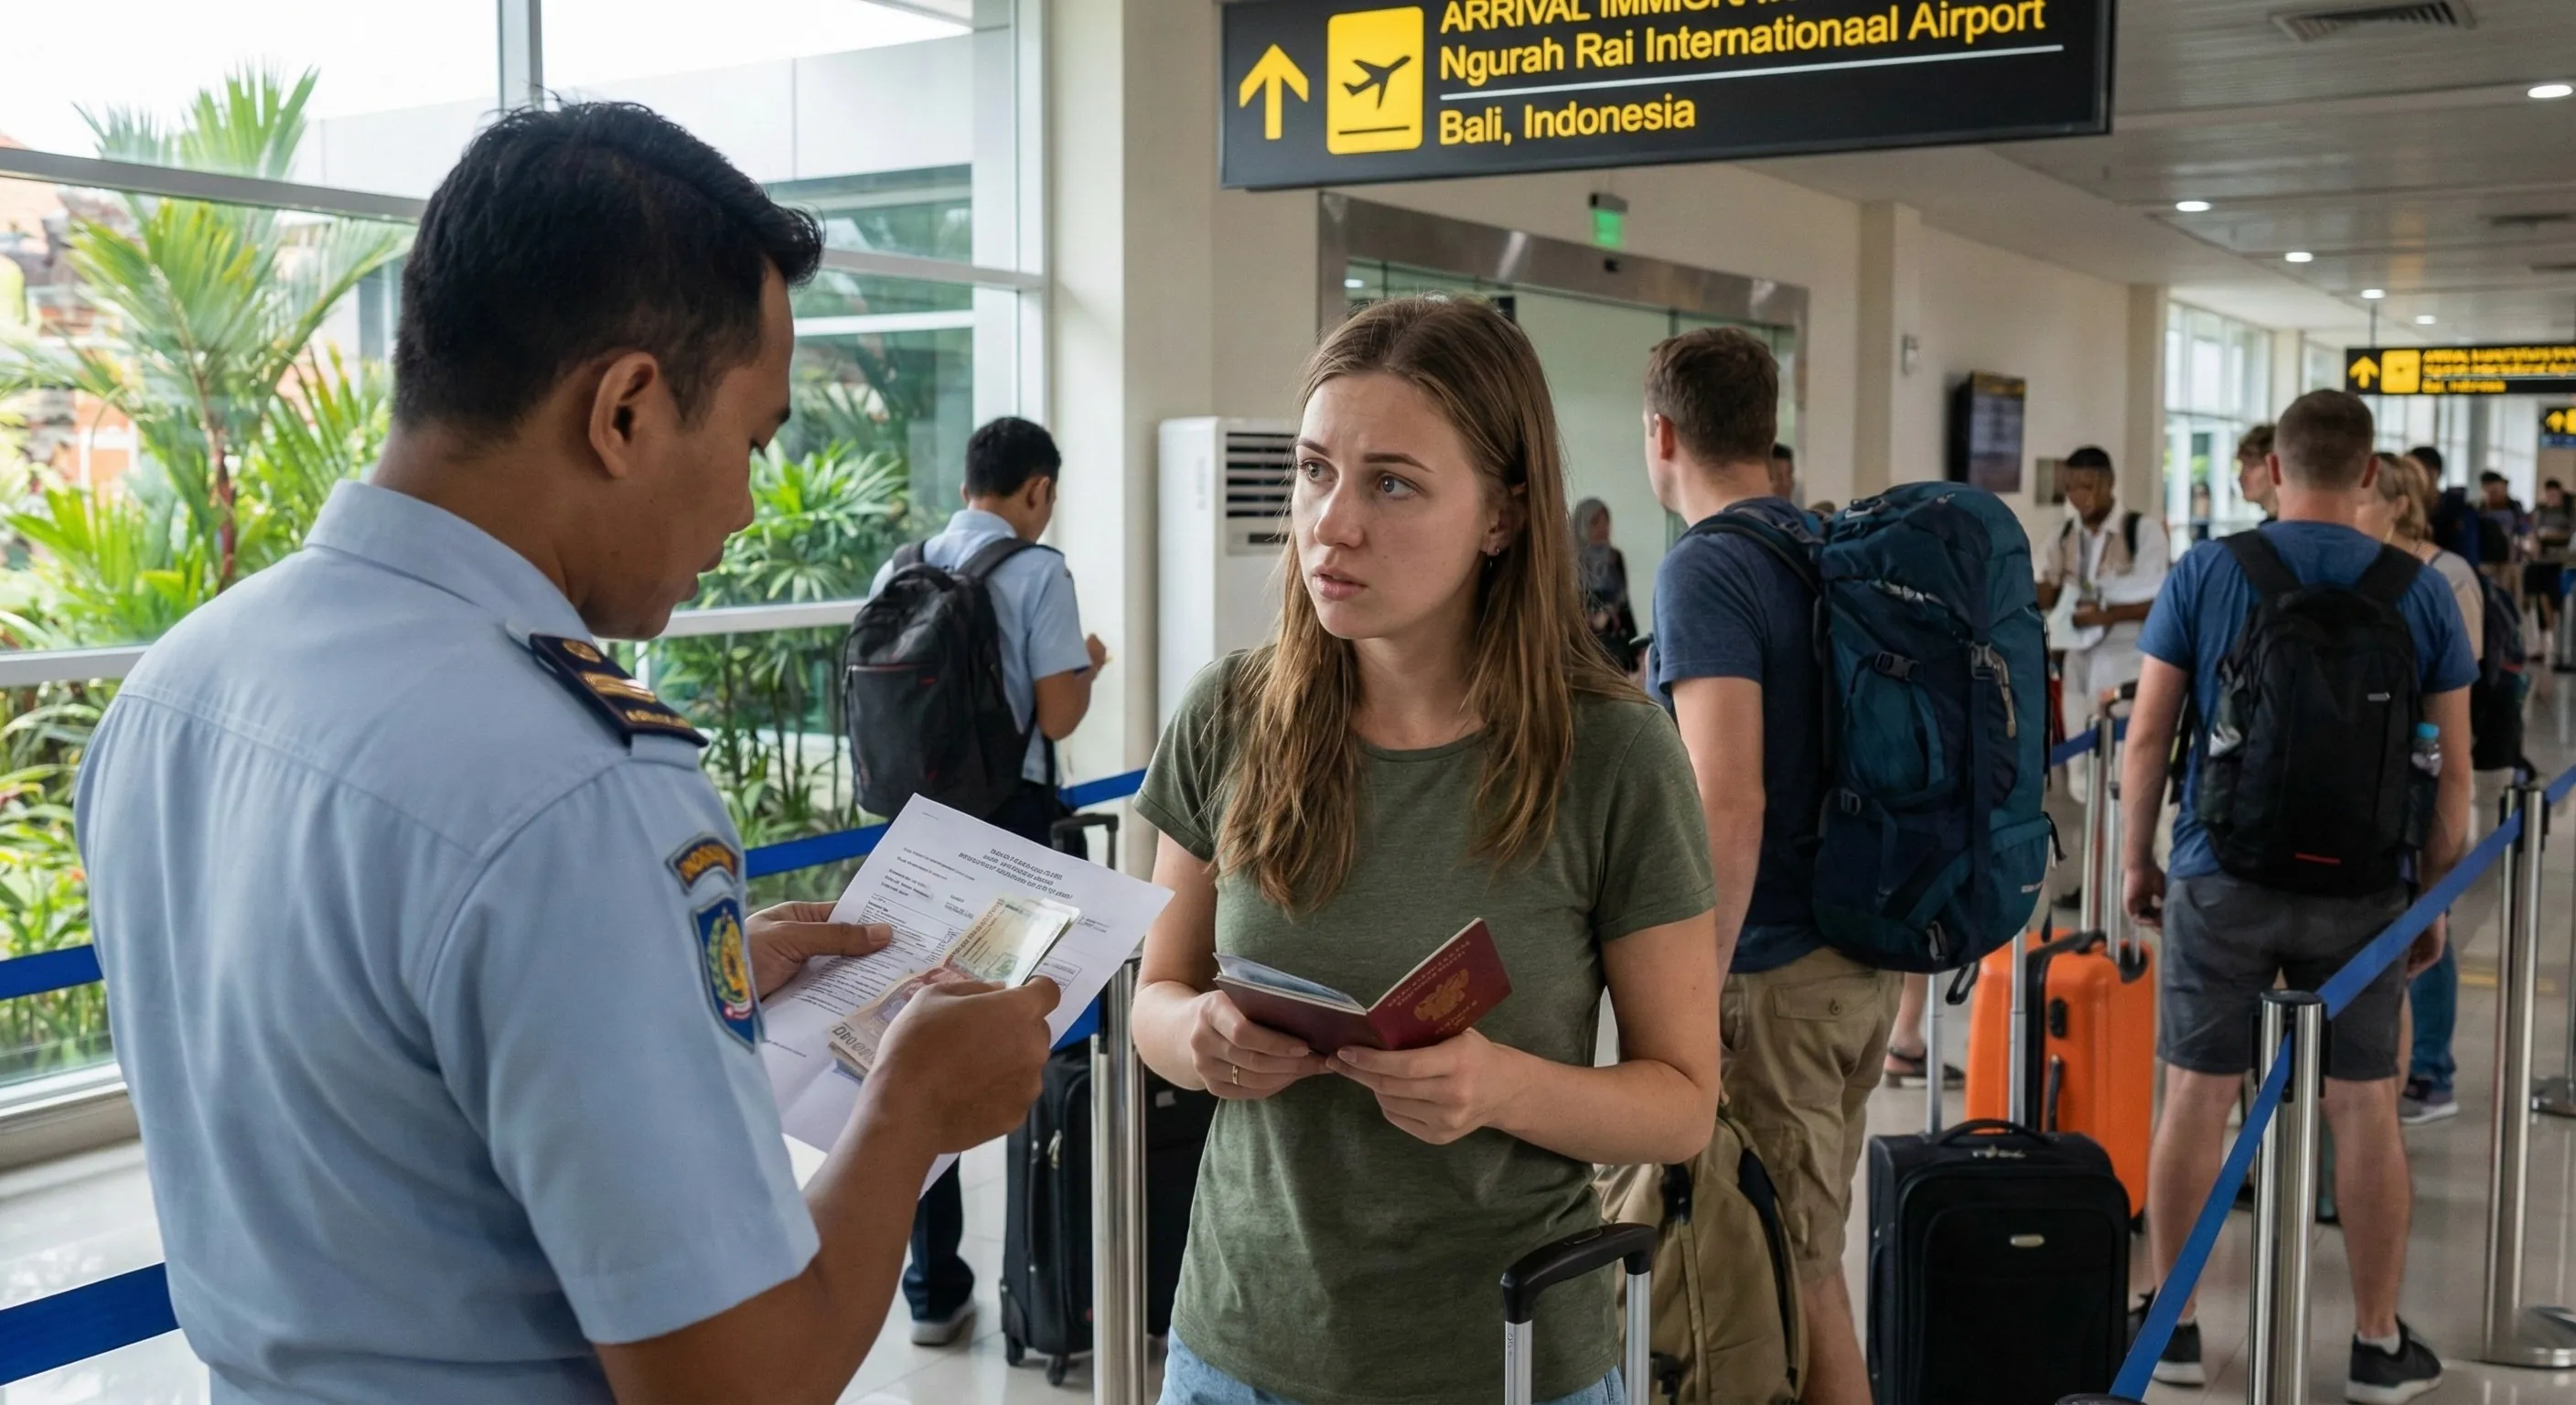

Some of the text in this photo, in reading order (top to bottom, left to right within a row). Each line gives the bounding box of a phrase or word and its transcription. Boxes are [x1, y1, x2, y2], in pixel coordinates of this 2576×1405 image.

[1439, 0, 1592, 35] ARRIVAL
[1439, 0, 2046, 88] Ngurah Rai Internationaal Airport
[1439, 93, 1696, 146] Bali, Indonesia
